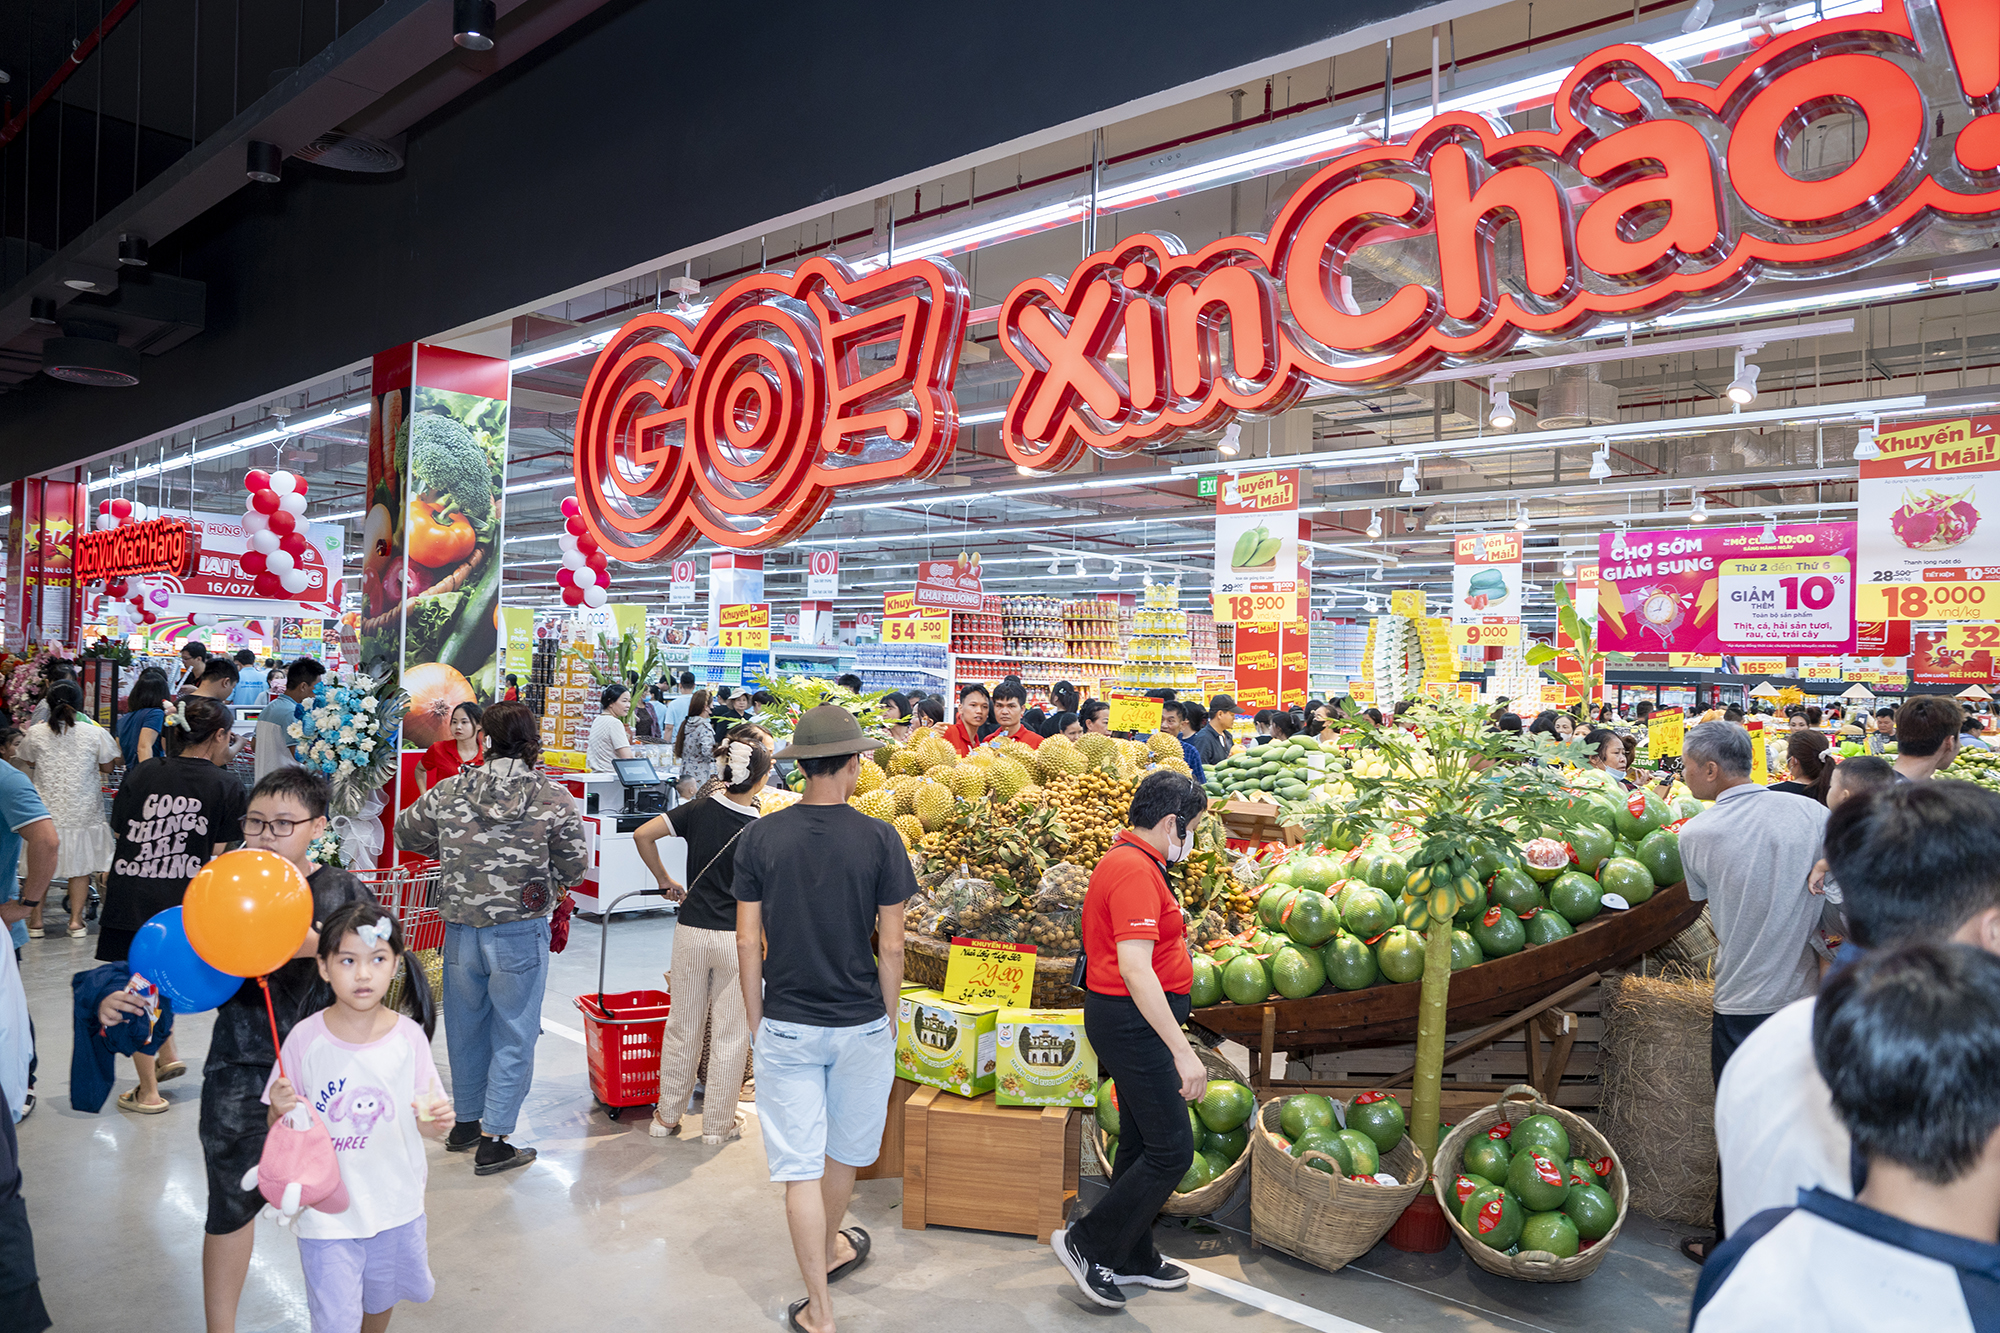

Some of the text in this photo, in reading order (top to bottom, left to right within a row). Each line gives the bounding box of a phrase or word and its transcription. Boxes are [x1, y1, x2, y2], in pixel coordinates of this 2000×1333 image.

[1874, 426, 1964, 454] Khuyến
[1941, 436, 1996, 468] Mãi!
[1200, 480, 1217, 494] EXI
[1260, 485, 1290, 507] Mãi!
[1461, 537, 1502, 551] Khyến
[1778, 534, 1815, 544] 10:00
[1610, 536, 1702, 562] CHỢ SỚM
[55, 566, 72, 574] LUÔ
[1602, 556, 1714, 581] GIẢM SUNG
[1735, 561, 1830, 572] Thứ 2 đến Thứ 6
[1731, 585, 1775, 602] GIẢM
[1881, 585, 1986, 618] 18.000
[887, 597, 915, 611] Khuy
[1228, 596, 1285, 620] 18.900
[1936, 605, 1981, 619] vnd/kg
[722, 608, 749, 620] Khuyến
[1793, 611, 1813, 619] phẩm
[1734, 621, 1832, 631] Thịt, cá, hải sản tươi,
[1466, 626, 1508, 644] 9.000
[1746, 630, 1819, 640] rau, củ, trái cây
[1949, 669, 1963, 678] RẺ
[1633, 759, 1655, 767] ETGAP
[142, 793, 202, 820] GOOD
[126, 813, 209, 843] THINGS
[134, 831, 189, 862] ARE
[114, 853, 203, 879] COMING
[971, 940, 1016, 951] KHUYẾN MÃI
[315, 1077, 347, 1113] BABY
[330, 1136, 369, 1152] THREE
